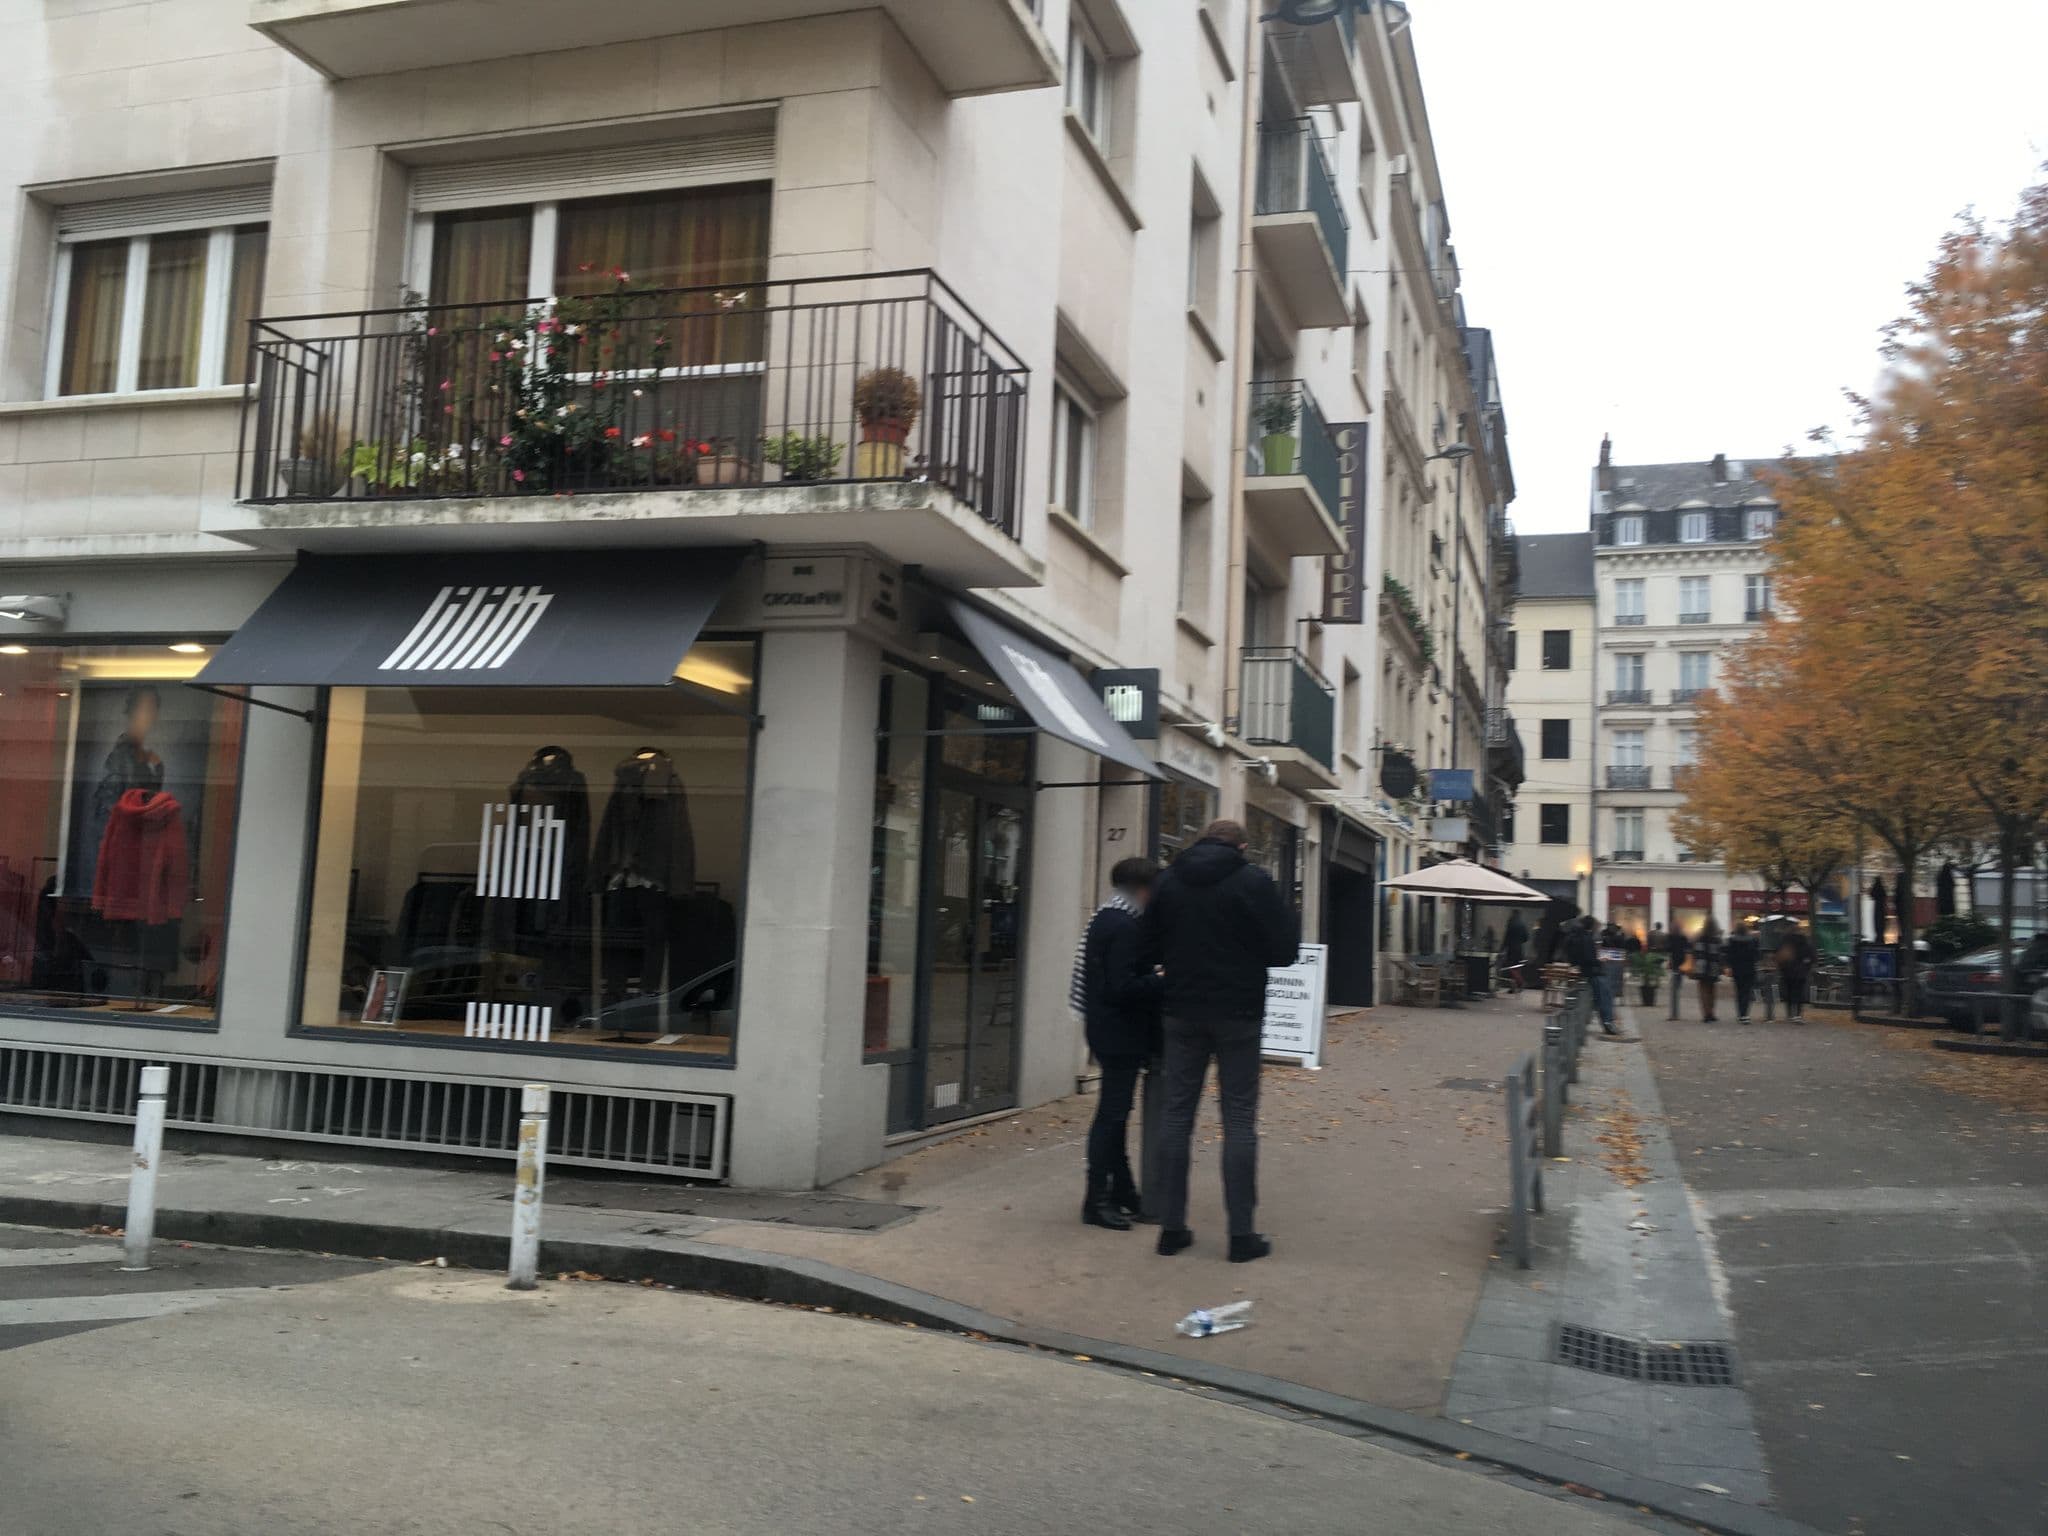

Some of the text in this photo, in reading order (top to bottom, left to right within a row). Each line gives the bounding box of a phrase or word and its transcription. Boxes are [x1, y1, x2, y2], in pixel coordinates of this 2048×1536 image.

[378, 586, 555, 670] lilith
[476, 803, 566, 900] lilith
[1107, 828, 1127, 841] 27
